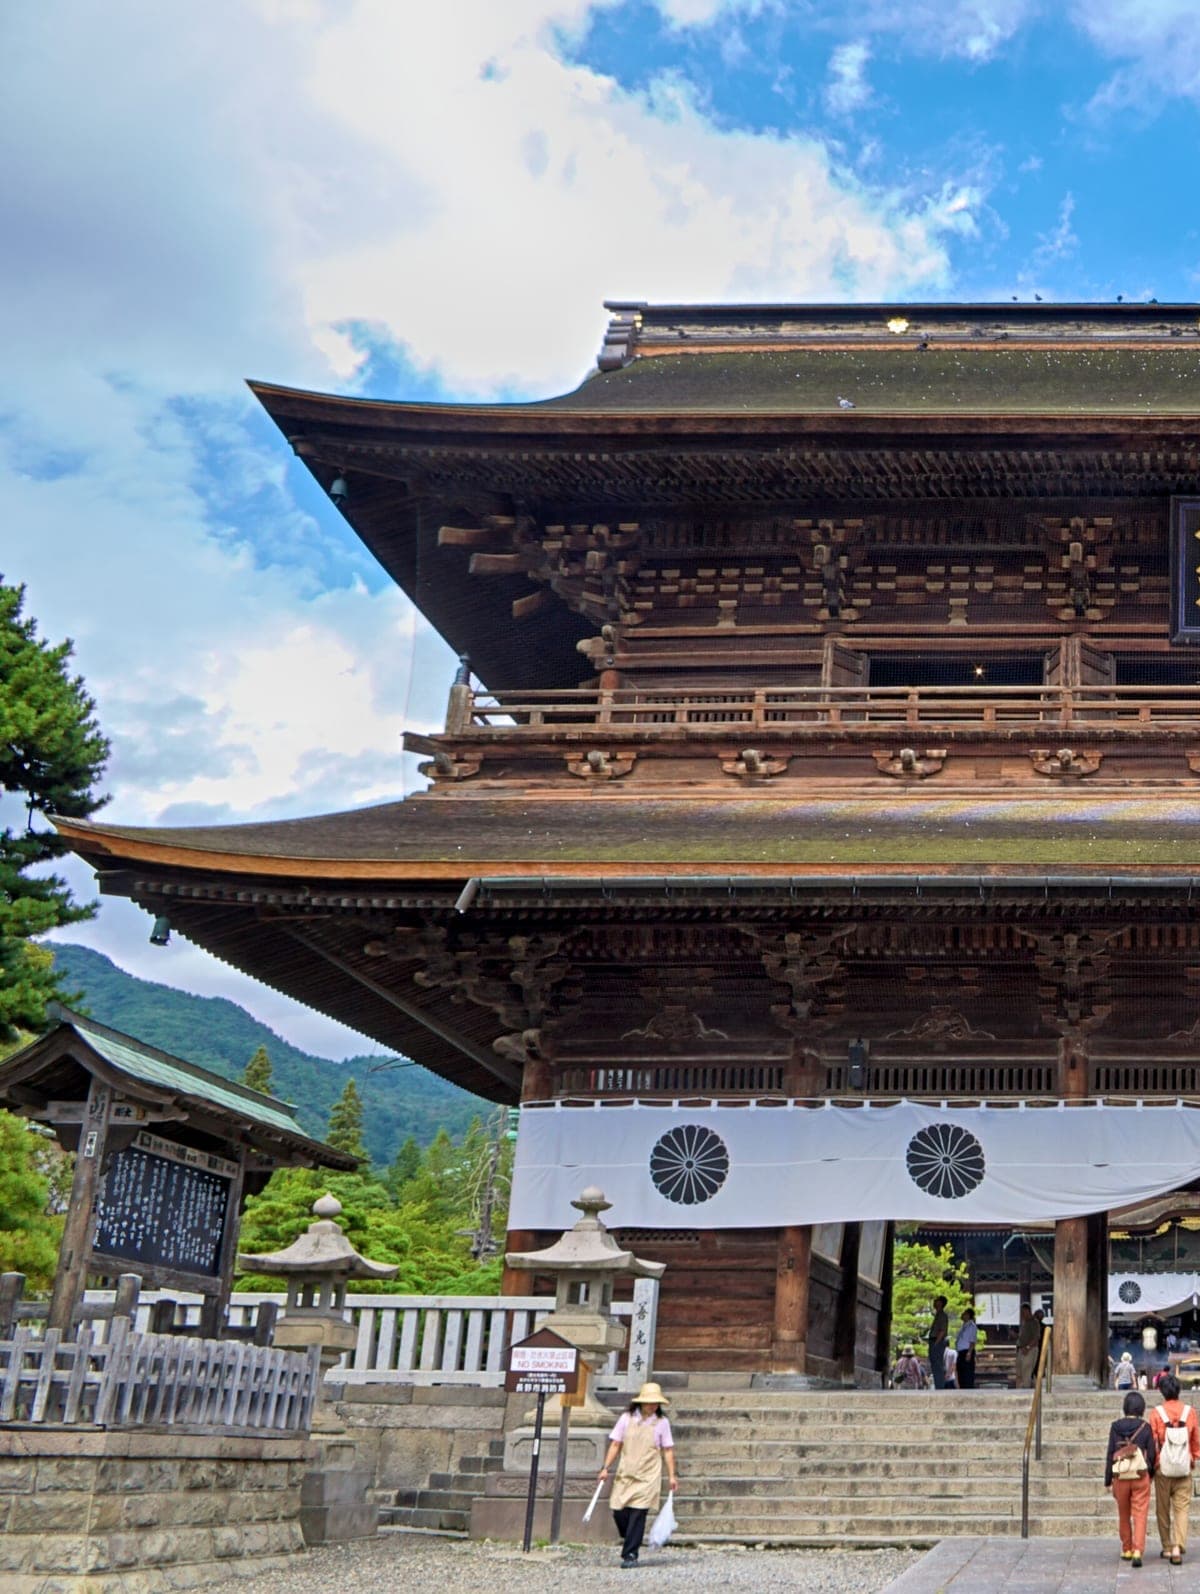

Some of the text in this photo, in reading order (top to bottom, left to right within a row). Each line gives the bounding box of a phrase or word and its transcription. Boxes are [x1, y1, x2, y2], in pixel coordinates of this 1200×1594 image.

[632, 1301, 649, 1372] 善光寺
[517, 1360, 568, 1369] NO SMOKING
